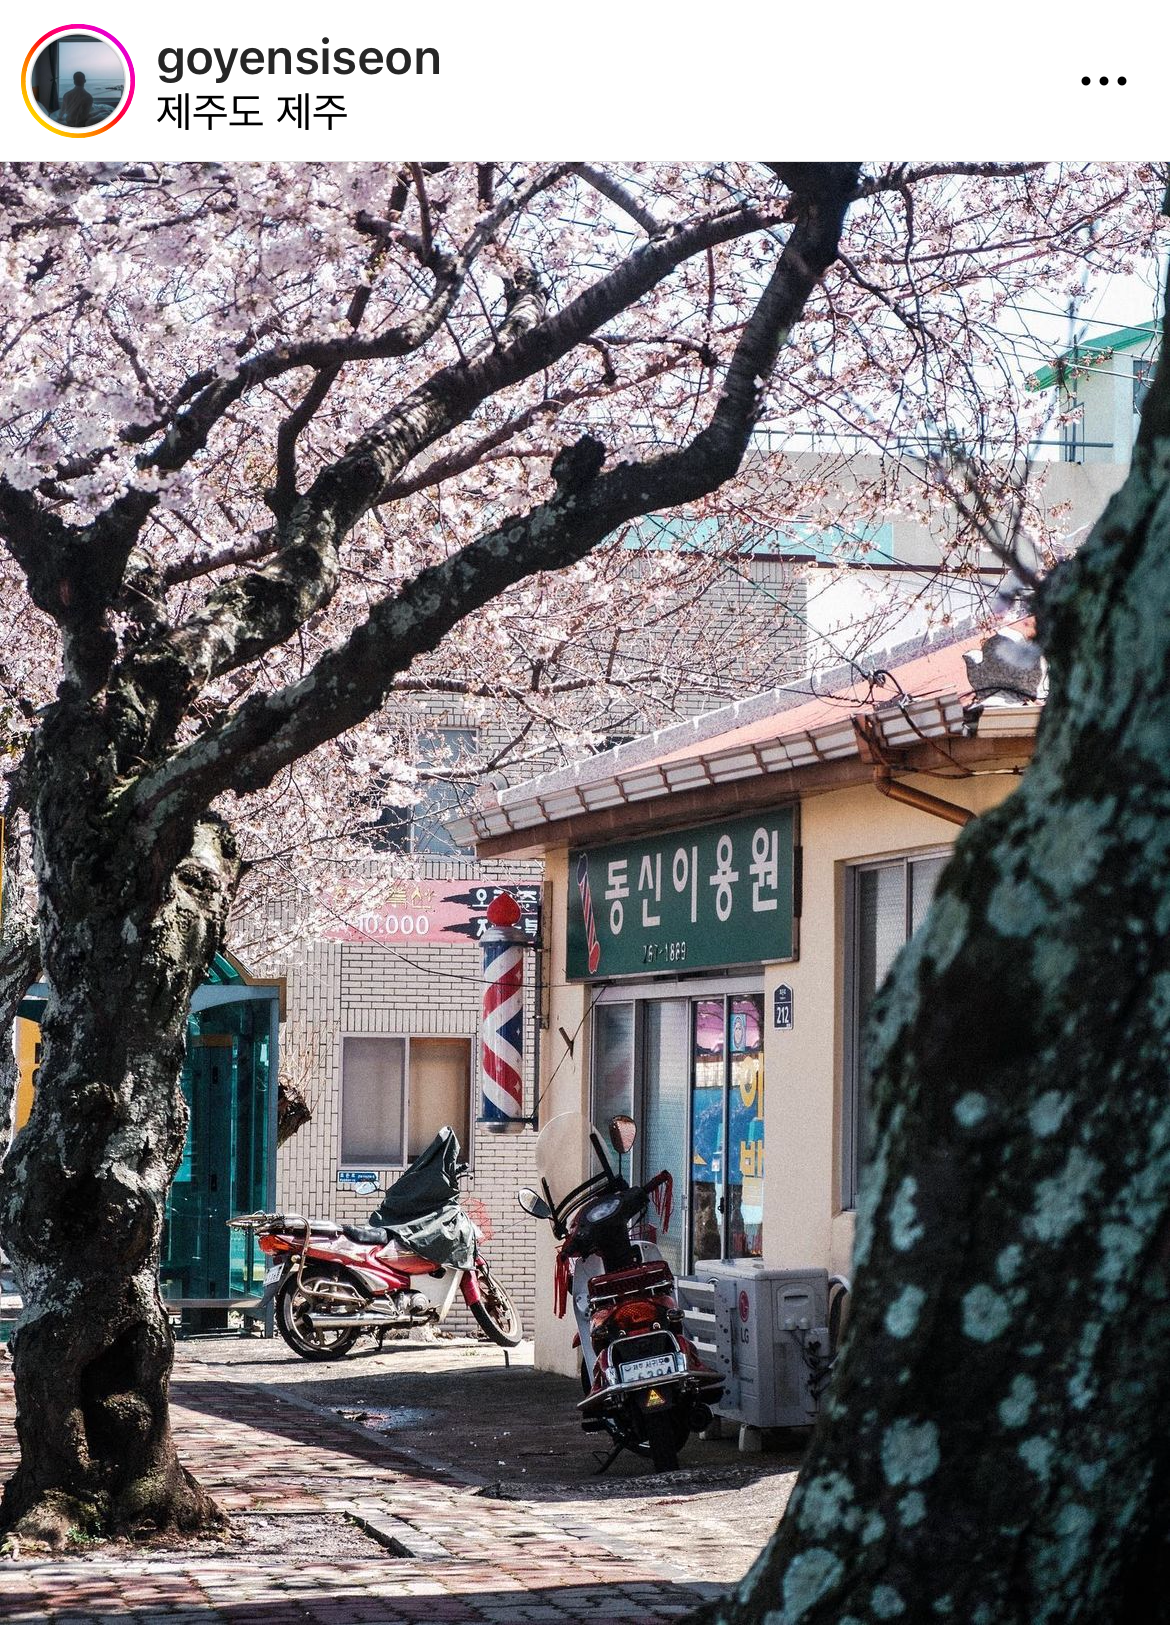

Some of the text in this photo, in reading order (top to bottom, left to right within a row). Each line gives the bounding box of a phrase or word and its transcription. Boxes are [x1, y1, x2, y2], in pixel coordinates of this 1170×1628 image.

[605, 828, 778, 935] 동신이용원
[777, 1006, 789, 1024] 212
[740, 1327, 750, 1345] LG
